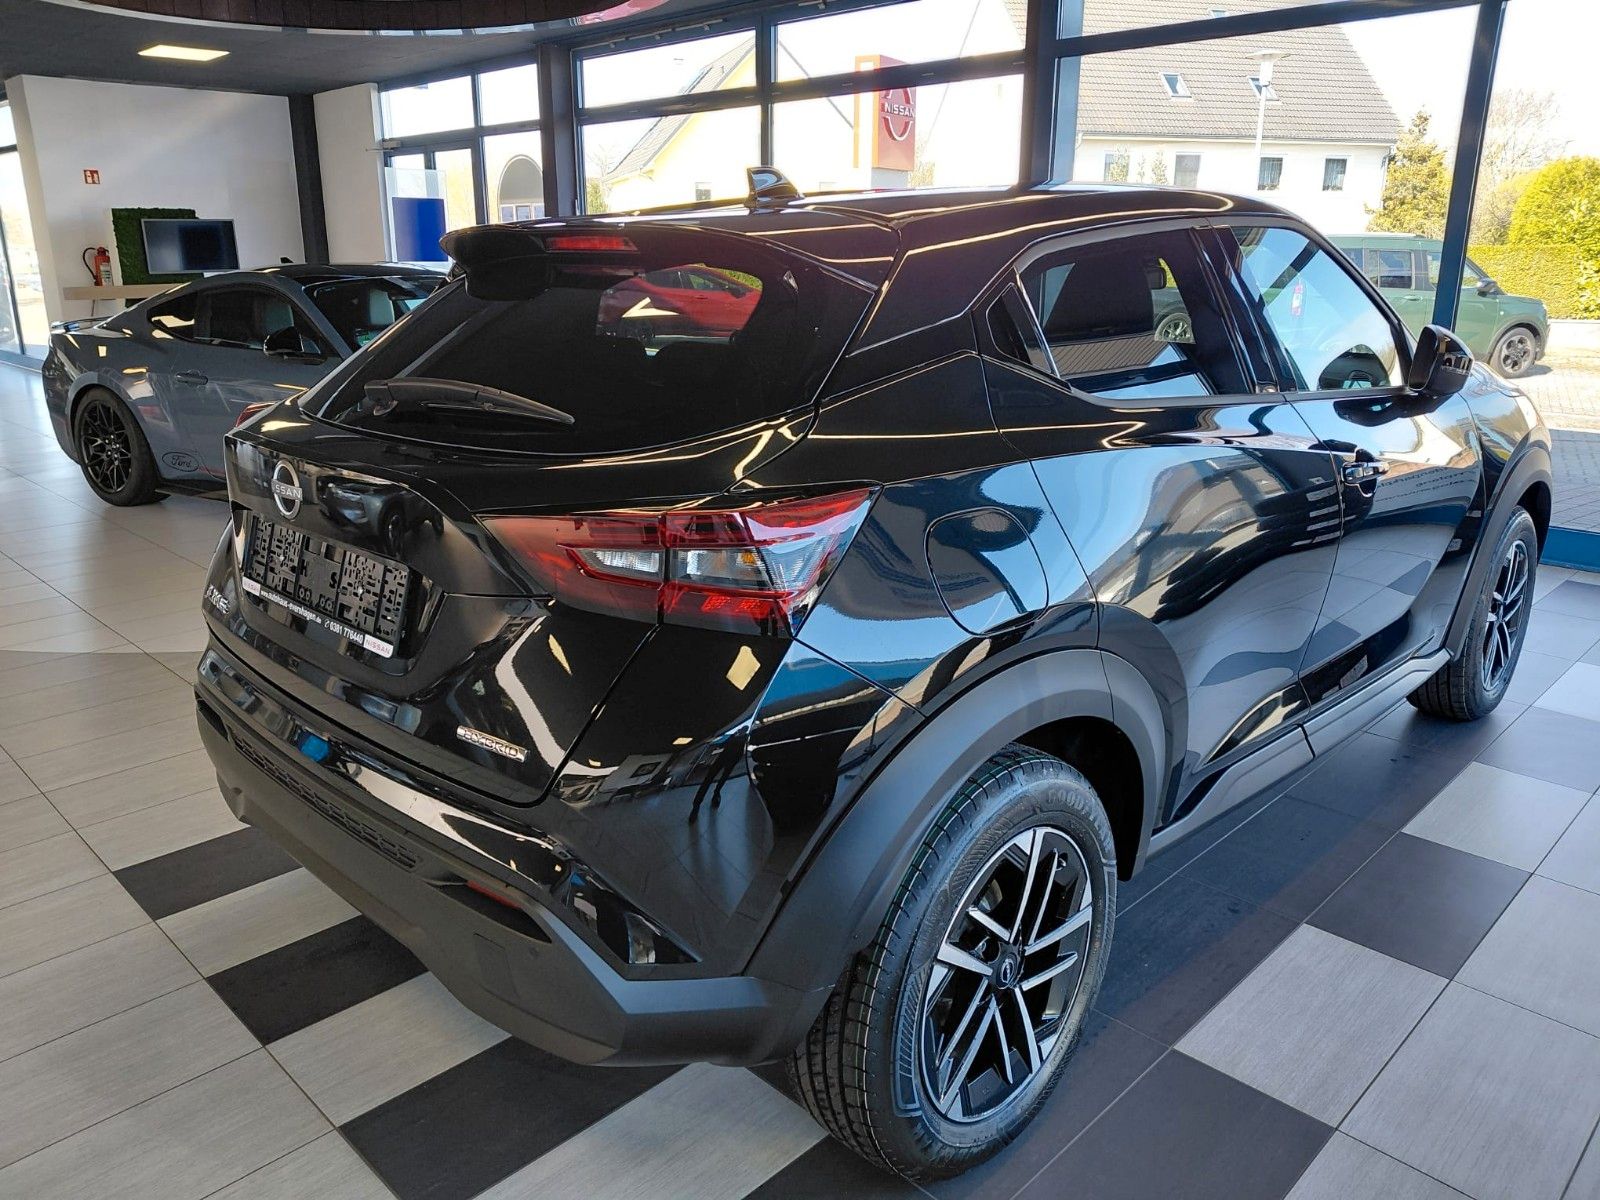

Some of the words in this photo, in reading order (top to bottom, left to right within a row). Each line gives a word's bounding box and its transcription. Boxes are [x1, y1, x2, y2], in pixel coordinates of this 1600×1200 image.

[884, 101, 915, 117] NISSAN
[272, 482, 301, 499] SSAN
[366, 639, 391, 655] NISSAN
[463, 729, 520, 757] HYBRID
